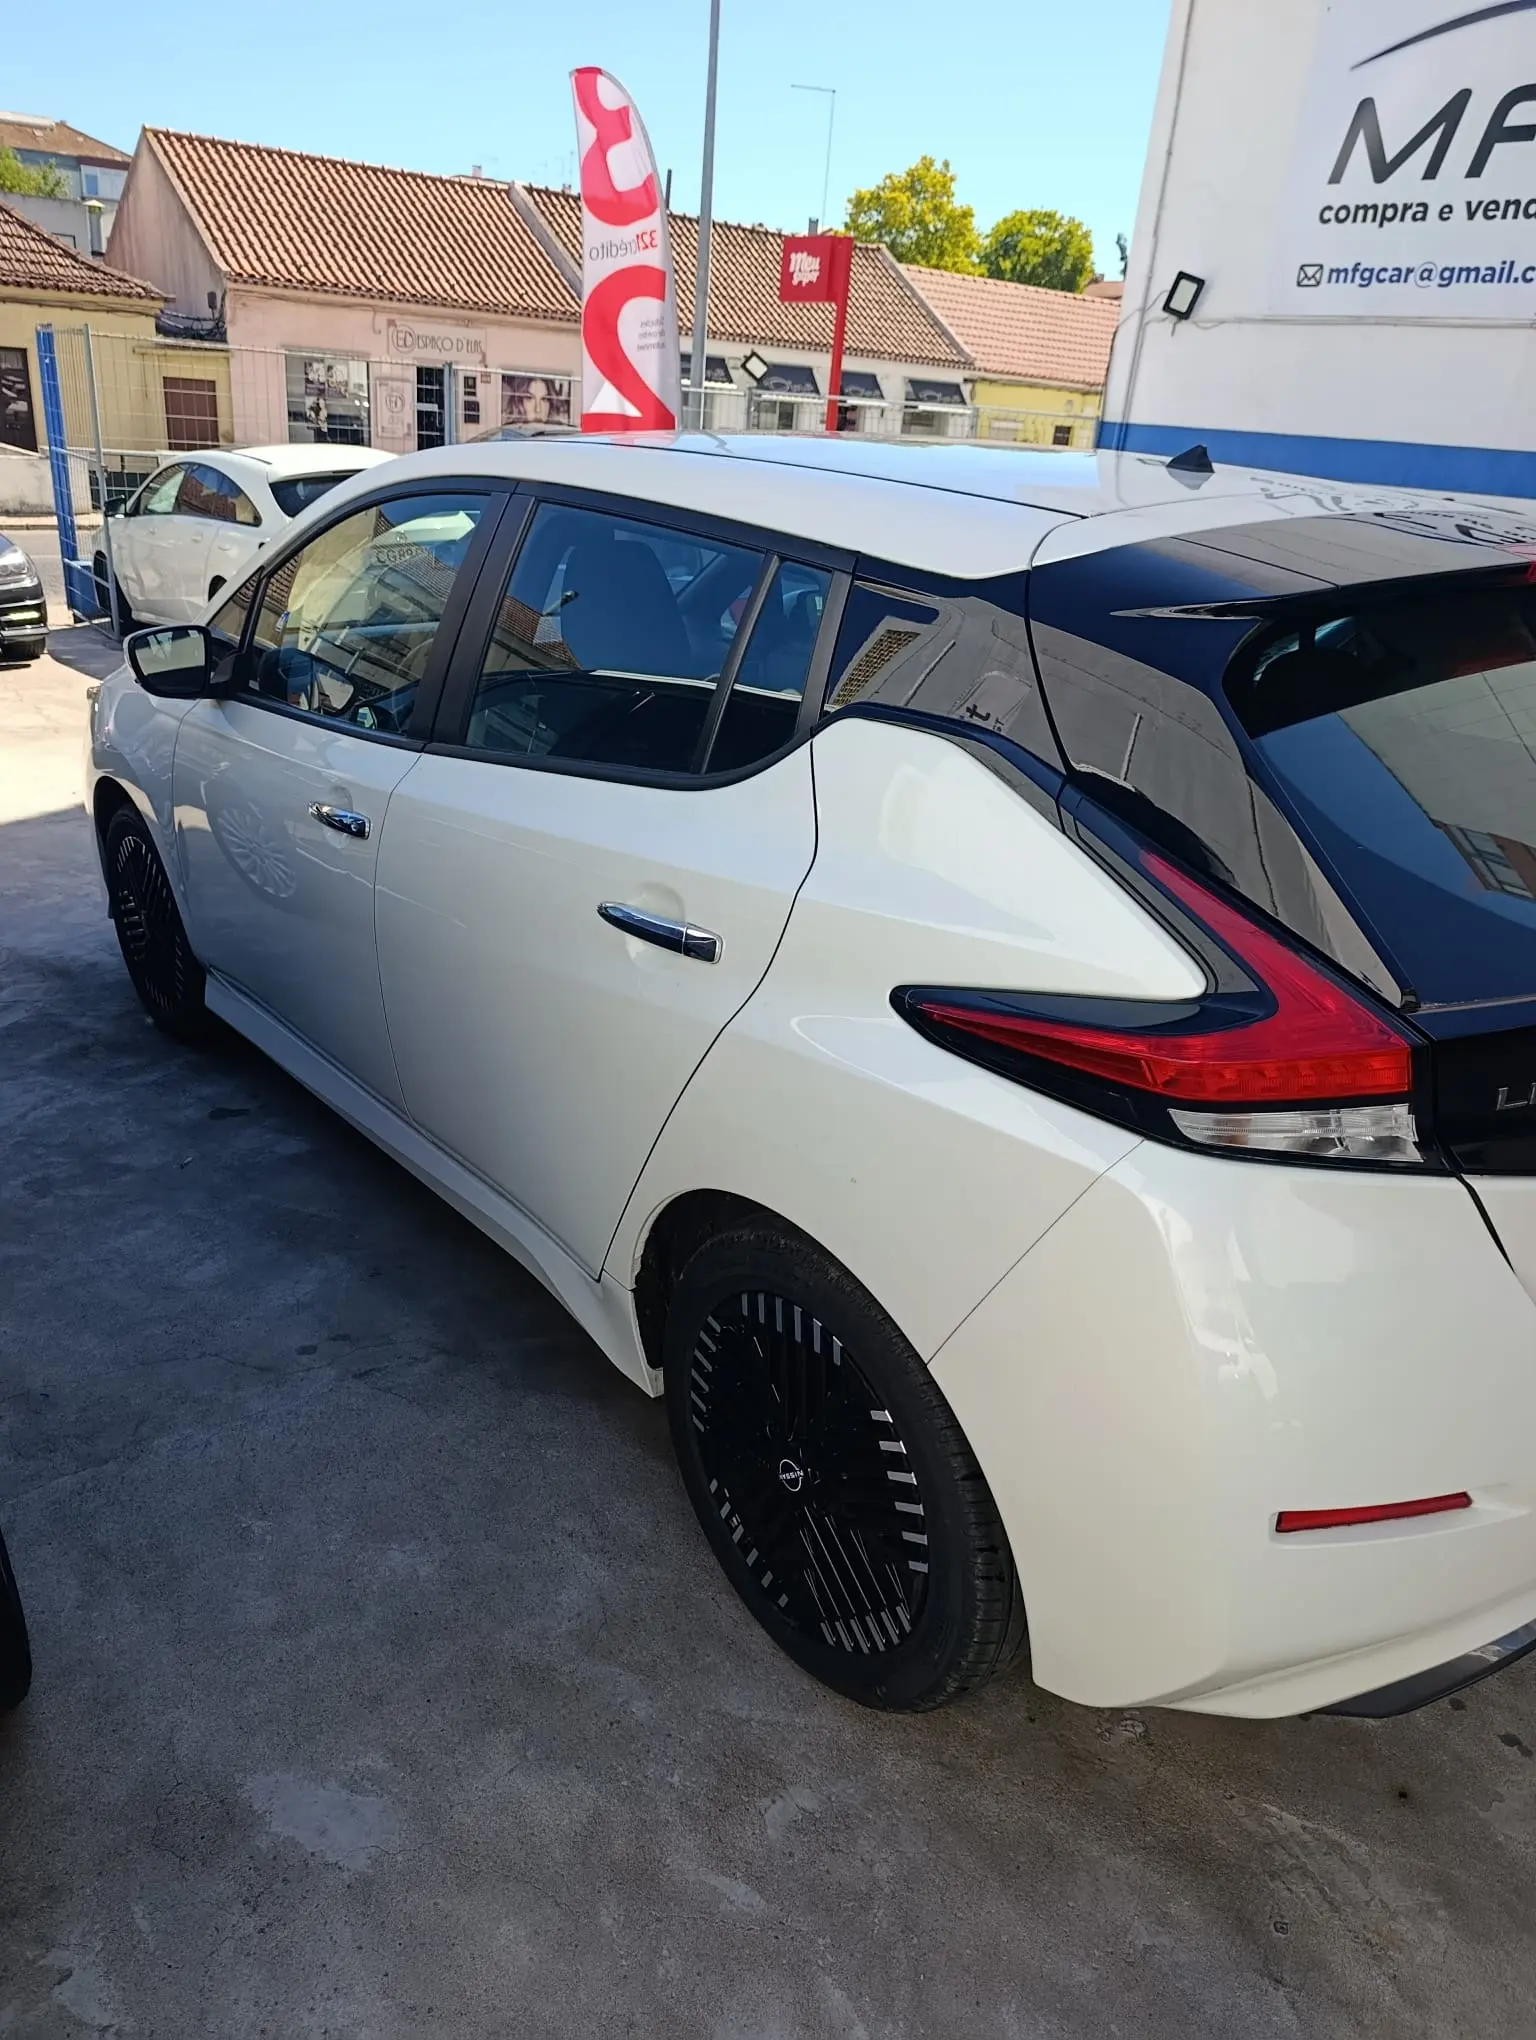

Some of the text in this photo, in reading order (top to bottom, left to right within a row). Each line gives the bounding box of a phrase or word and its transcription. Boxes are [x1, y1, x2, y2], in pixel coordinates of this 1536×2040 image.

[1318, 201, 1429, 228] compra
[1438, 203, 1453, 222] e
[1496, 1082, 1536, 1111] L
